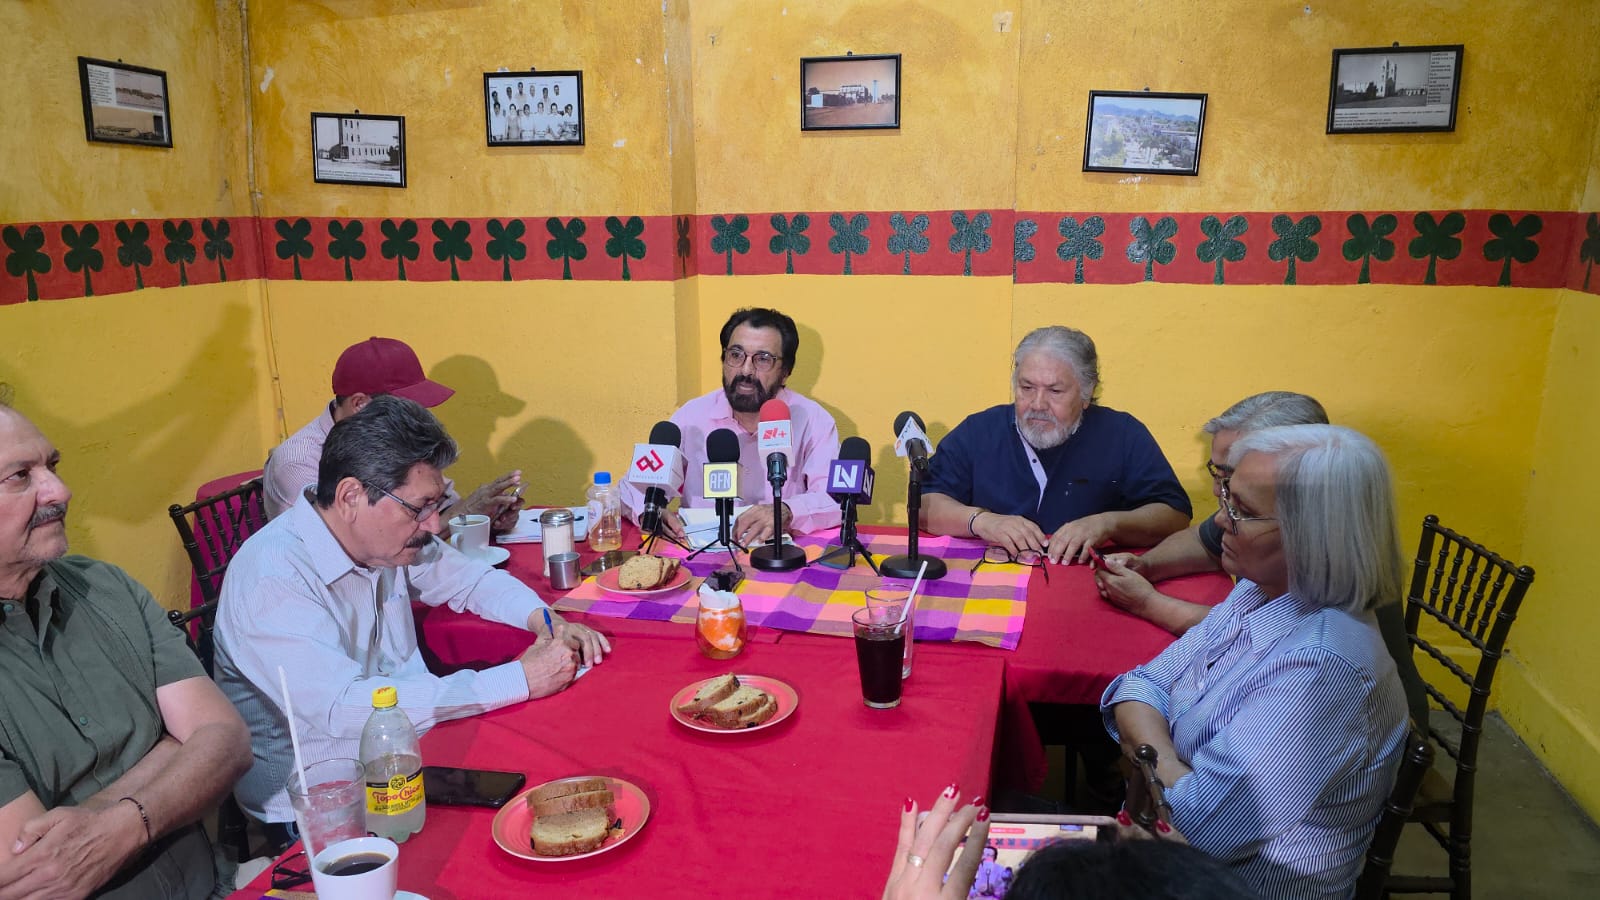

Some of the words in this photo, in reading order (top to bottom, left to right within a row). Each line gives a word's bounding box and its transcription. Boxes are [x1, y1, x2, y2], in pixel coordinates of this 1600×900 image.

[710, 472, 730, 490] AFN
[372, 791, 399, 805] Topo
[399, 784, 421, 800] Chico
